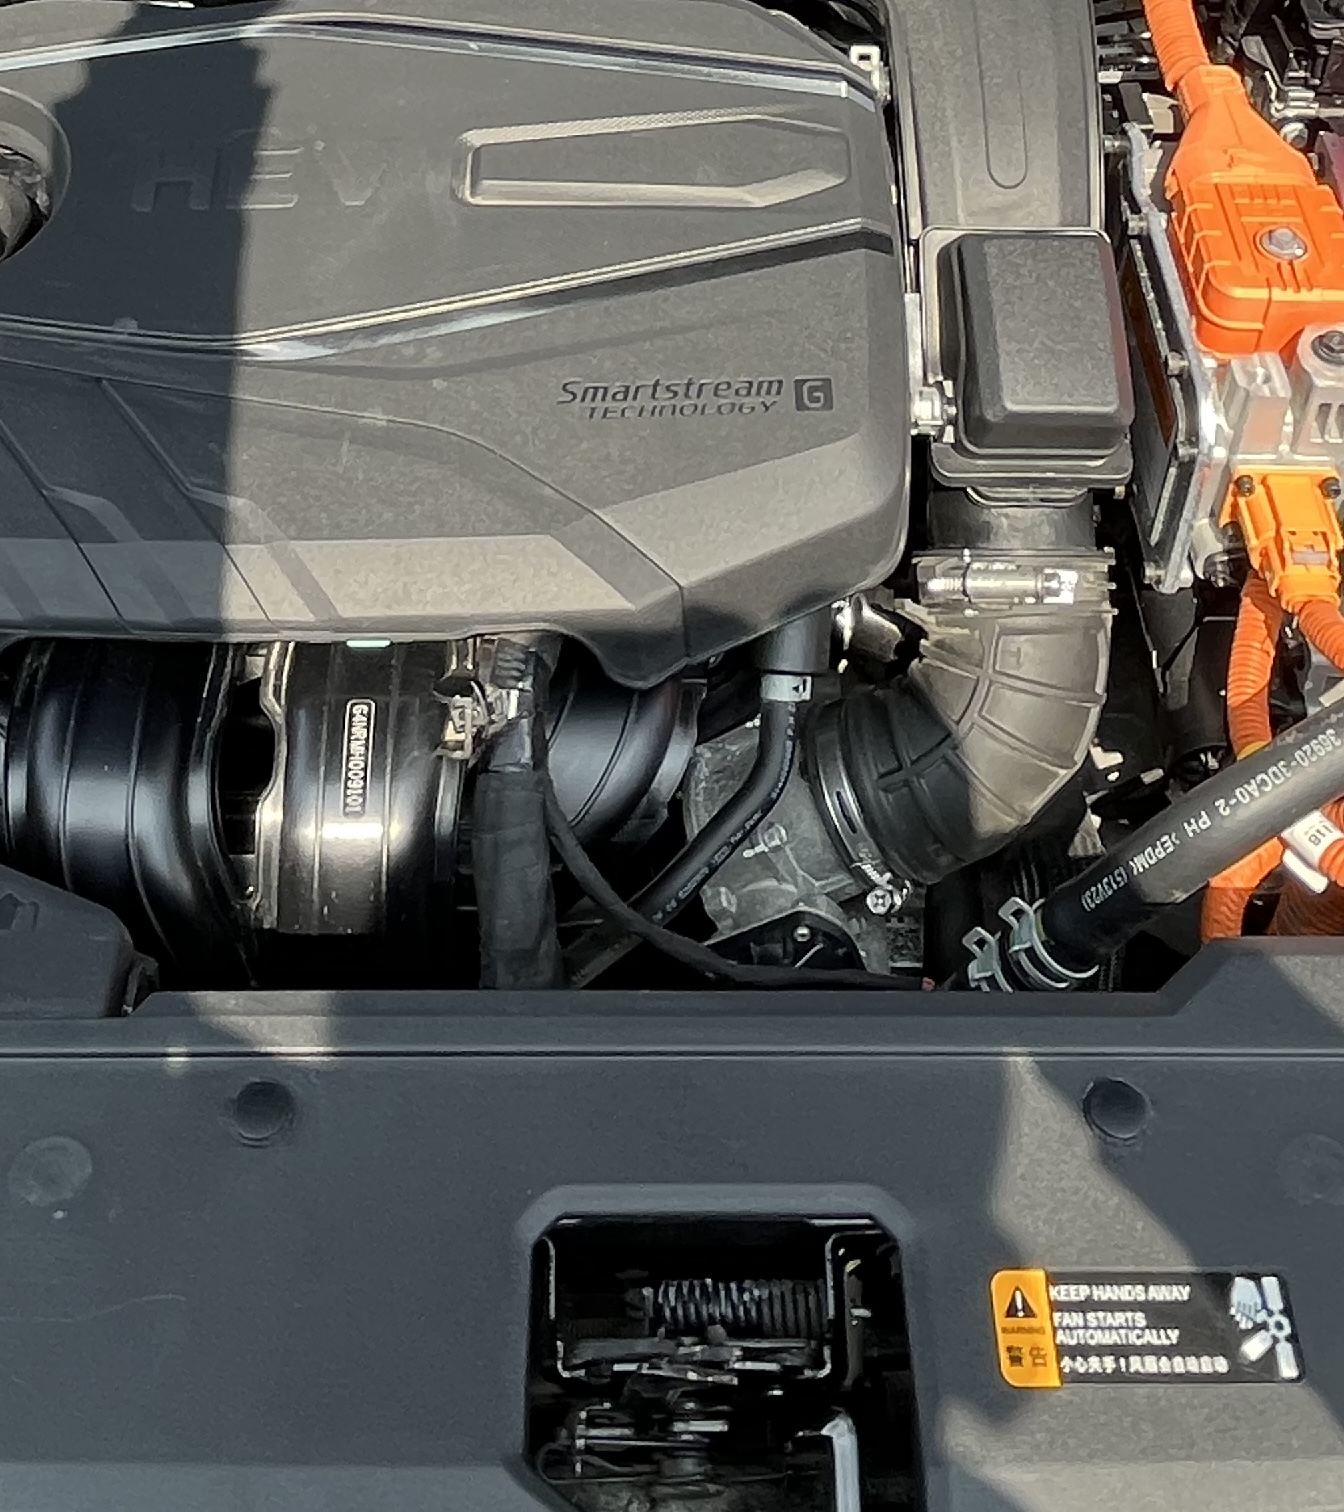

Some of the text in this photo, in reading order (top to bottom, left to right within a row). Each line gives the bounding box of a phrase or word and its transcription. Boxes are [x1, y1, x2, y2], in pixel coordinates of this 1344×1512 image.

[131, 140, 388, 212] HEV
[556, 377, 830, 409] Smartstream G
[587, 400, 778, 420] TECHNOLOGY
[1215, 728, 1343, 816] 36920-3DCA0-2
[1184, 811, 1212, 838] PH
[1081, 866, 1128, 912] (513V23)
[1049, 1284, 1191, 1301] KEEP HANDS AWAY
[1001, 1326, 1046, 1335] WARNING
[1052, 1311, 1147, 1328] FAN STARTS
[1055, 1328, 1180, 1346] AUTOMATICALLY
